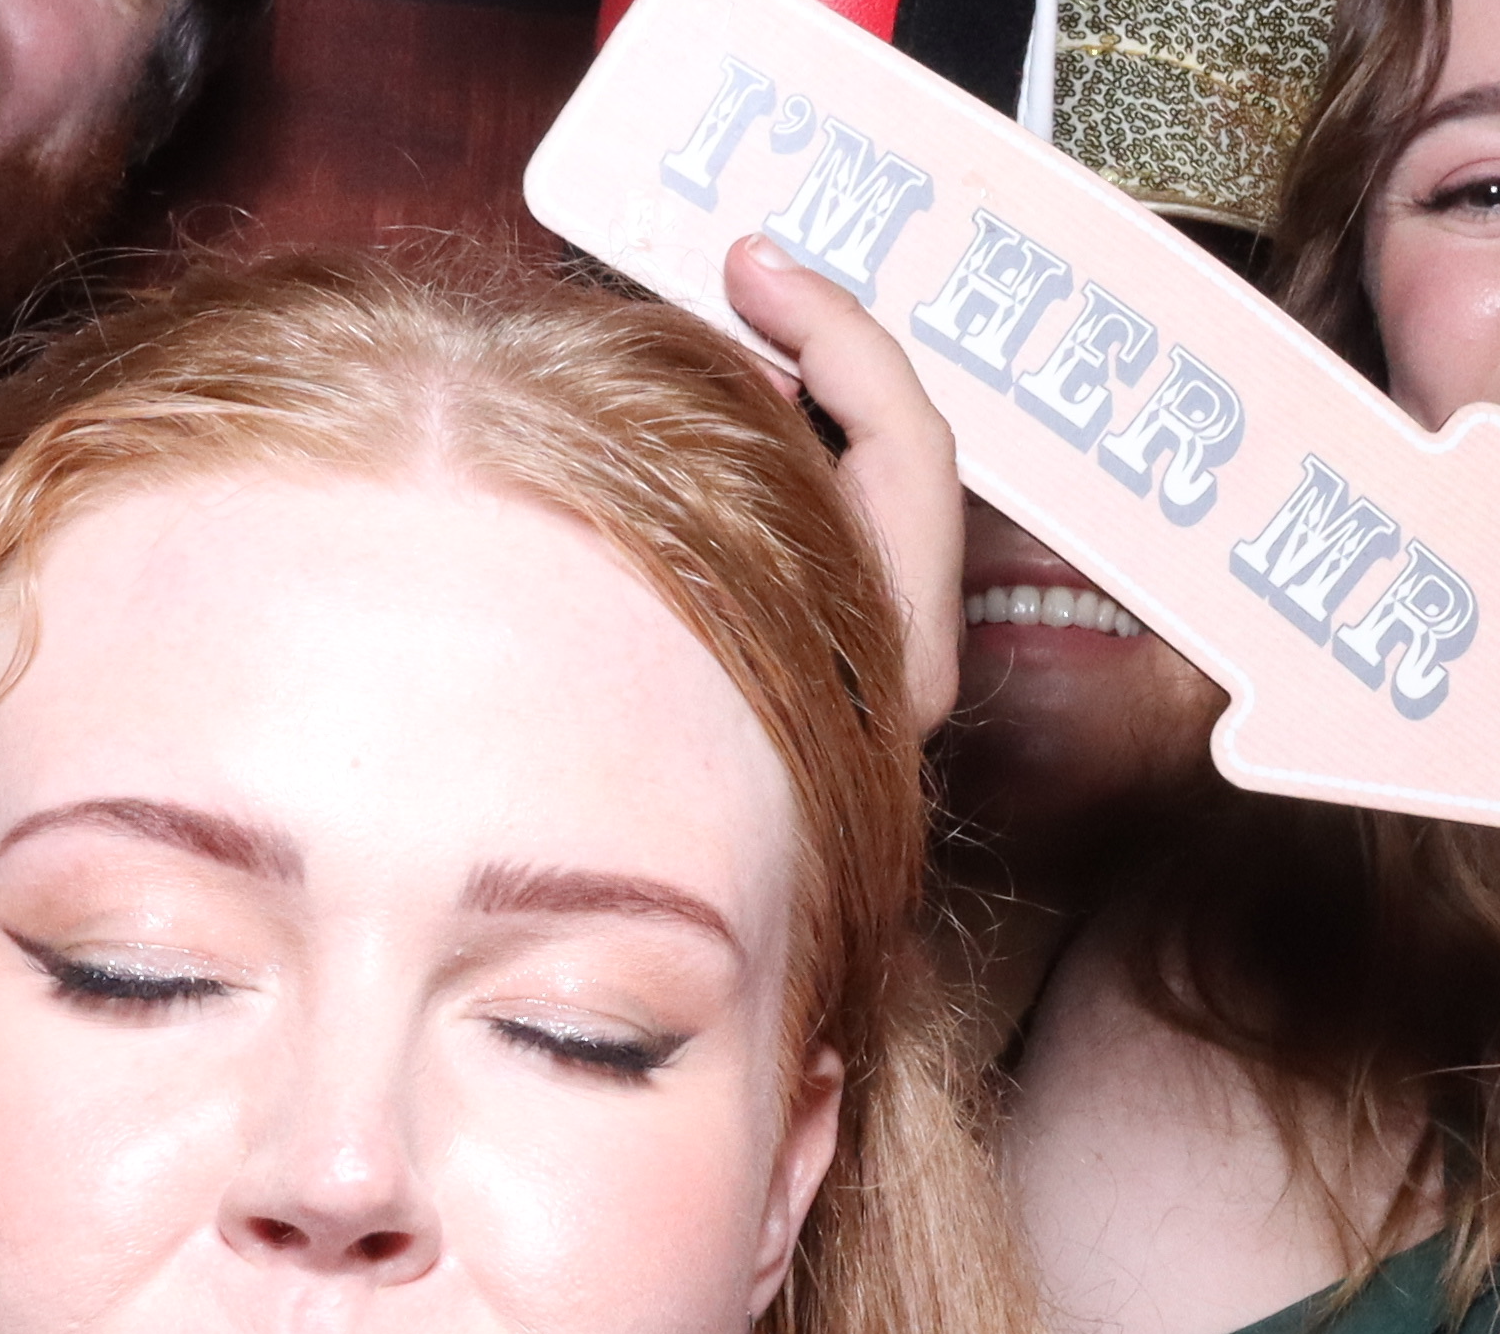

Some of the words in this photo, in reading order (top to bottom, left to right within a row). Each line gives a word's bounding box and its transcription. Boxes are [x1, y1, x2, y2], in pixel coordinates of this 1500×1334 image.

[659, 54, 935, 308] I'M
[909, 207, 1246, 527] HER
[1229, 451, 1479, 721] MR
